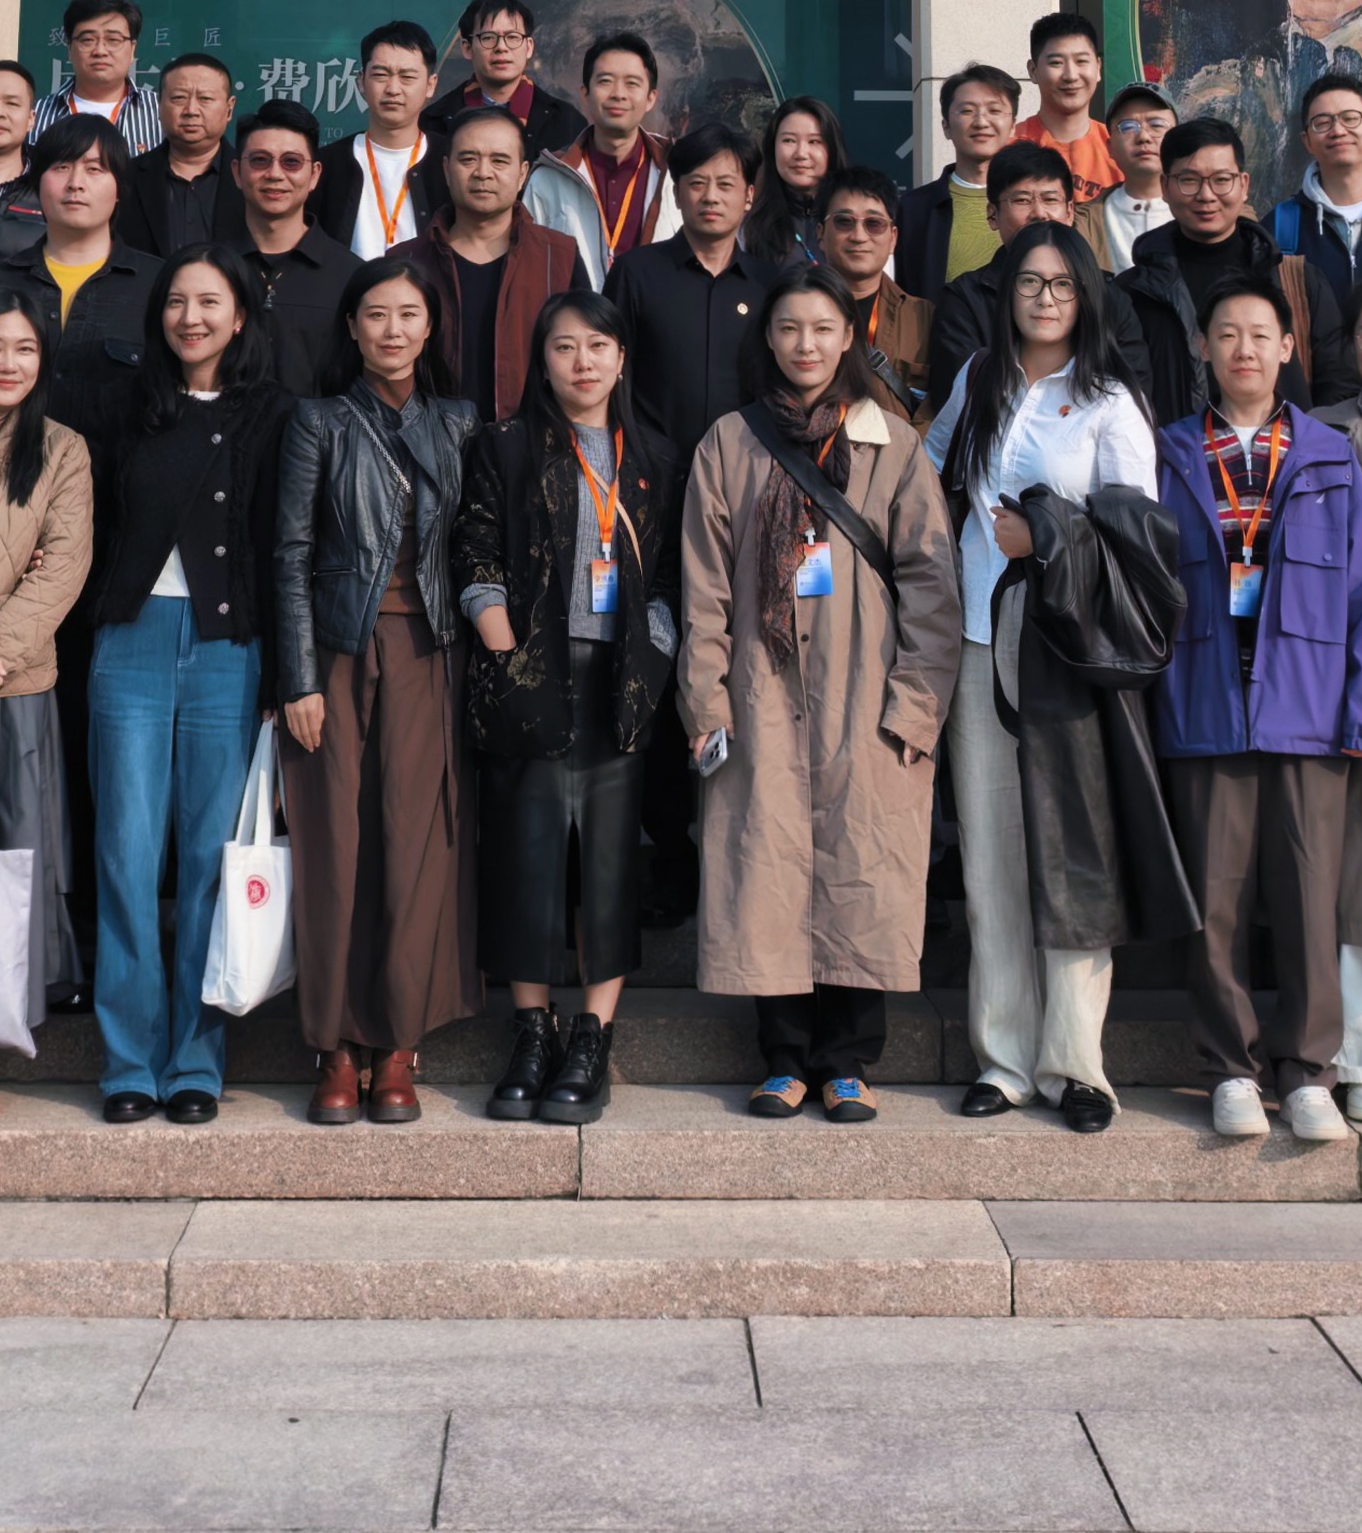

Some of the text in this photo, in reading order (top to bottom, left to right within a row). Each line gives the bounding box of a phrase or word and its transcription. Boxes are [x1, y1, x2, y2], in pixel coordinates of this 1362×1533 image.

[48, 28, 222, 47] 致巨匠
[324, 127, 343, 138] TO
